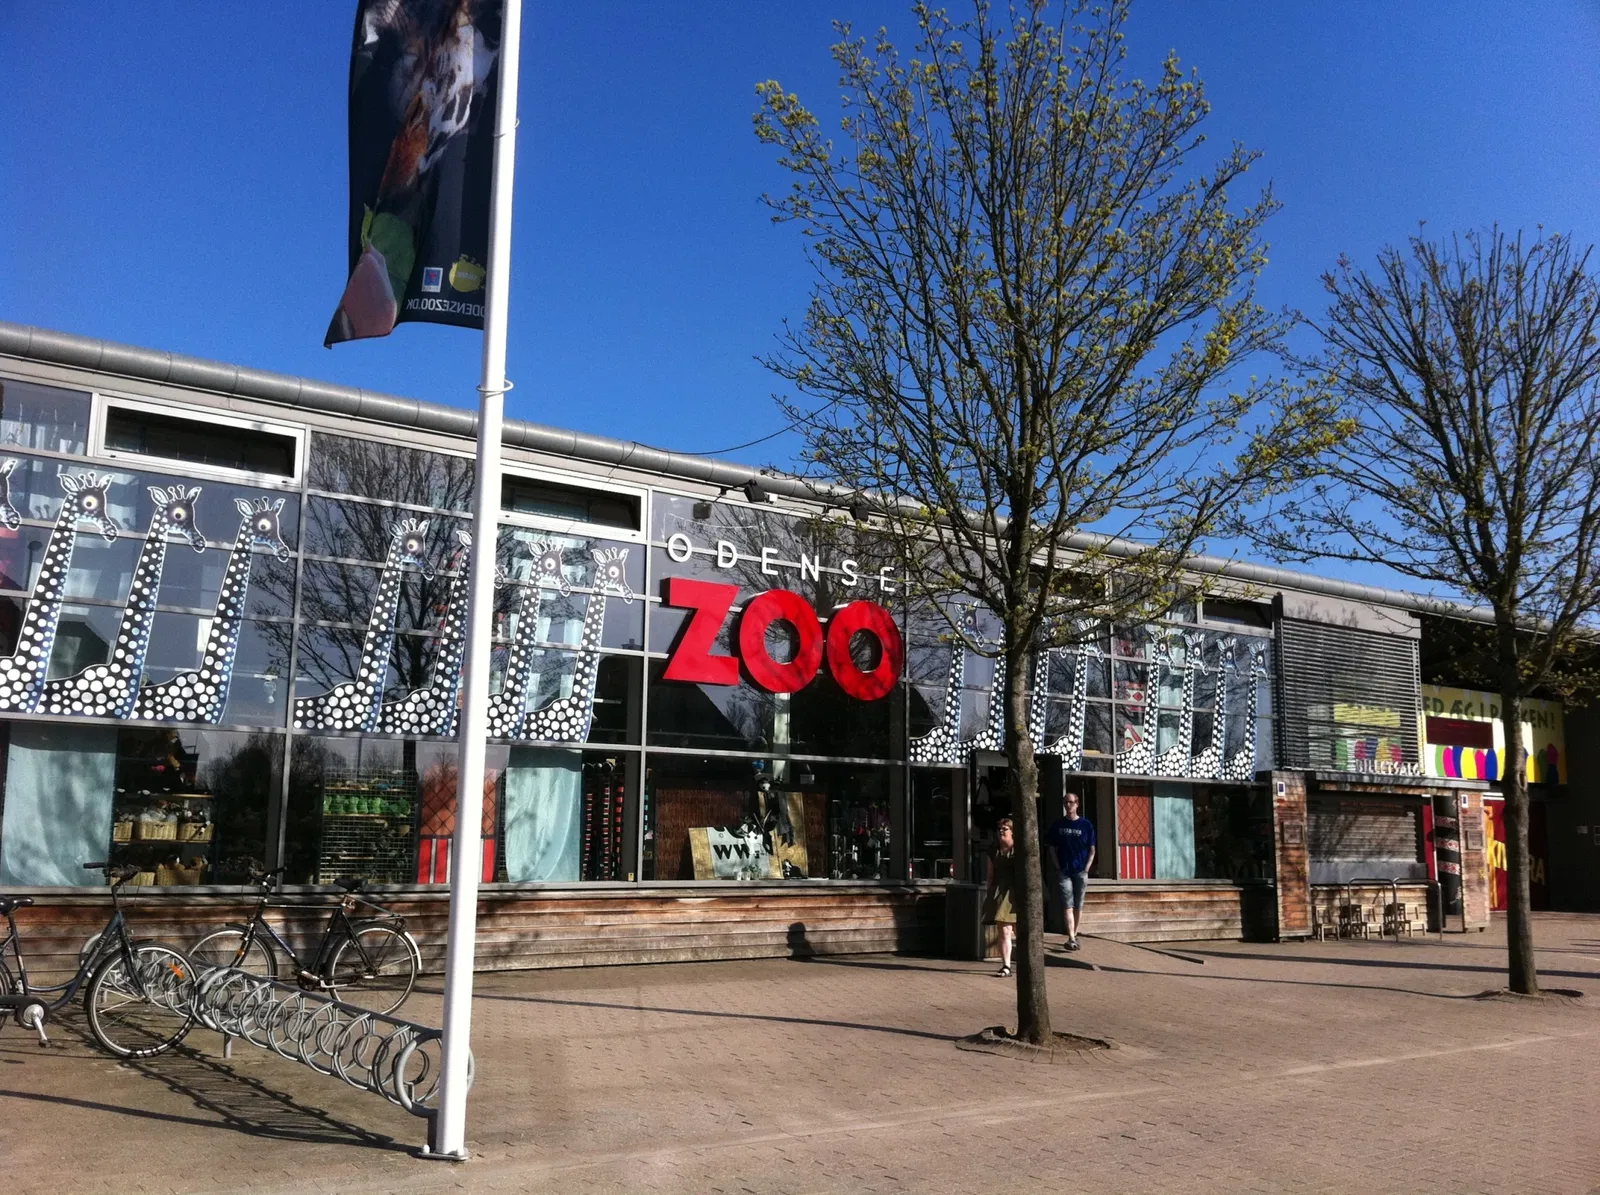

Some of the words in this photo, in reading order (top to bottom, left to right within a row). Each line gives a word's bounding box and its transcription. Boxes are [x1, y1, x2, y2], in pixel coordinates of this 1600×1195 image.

[667, 532, 896, 593] ODENSE
[660, 576, 905, 702] ZOO
[1422, 695, 1445, 716] ED
[1491, 703, 1556, 730] PKEN!
[1355, 758, 1421, 777] BILLETSALG
[712, 844, 760, 860] WW
